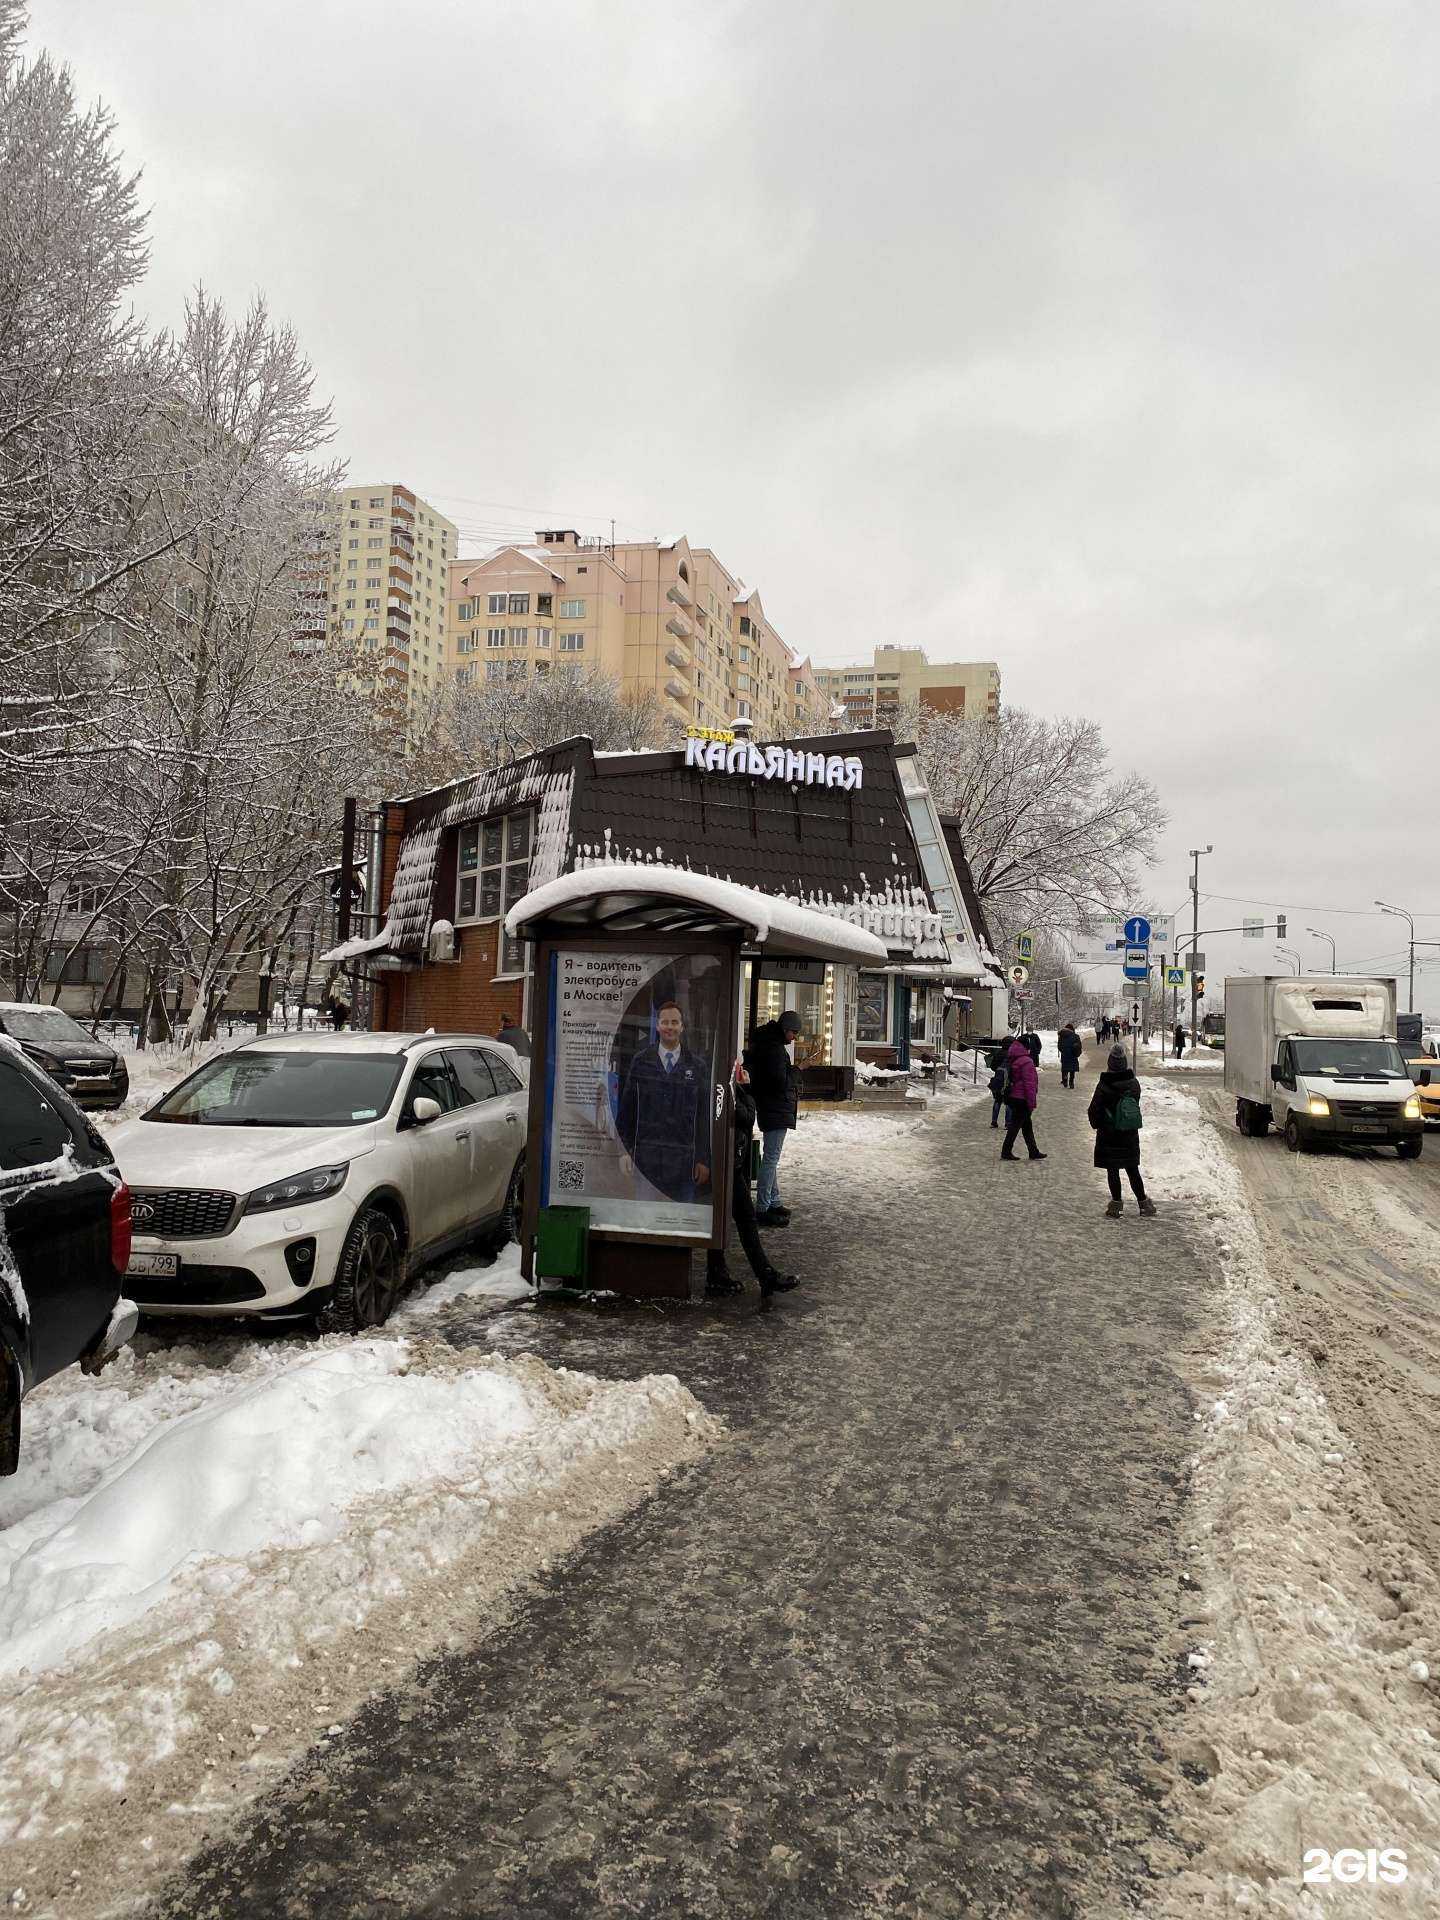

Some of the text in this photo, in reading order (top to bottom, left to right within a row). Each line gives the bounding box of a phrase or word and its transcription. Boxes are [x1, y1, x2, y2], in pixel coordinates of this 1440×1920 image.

[685, 736, 864, 791] КАЛЬЯННАЯ
[564, 959, 574, 969] Я
[586, 962, 642, 972] водитель
[563, 975, 639, 989] электробуса
[563, 989, 623, 1001] в Москве!
